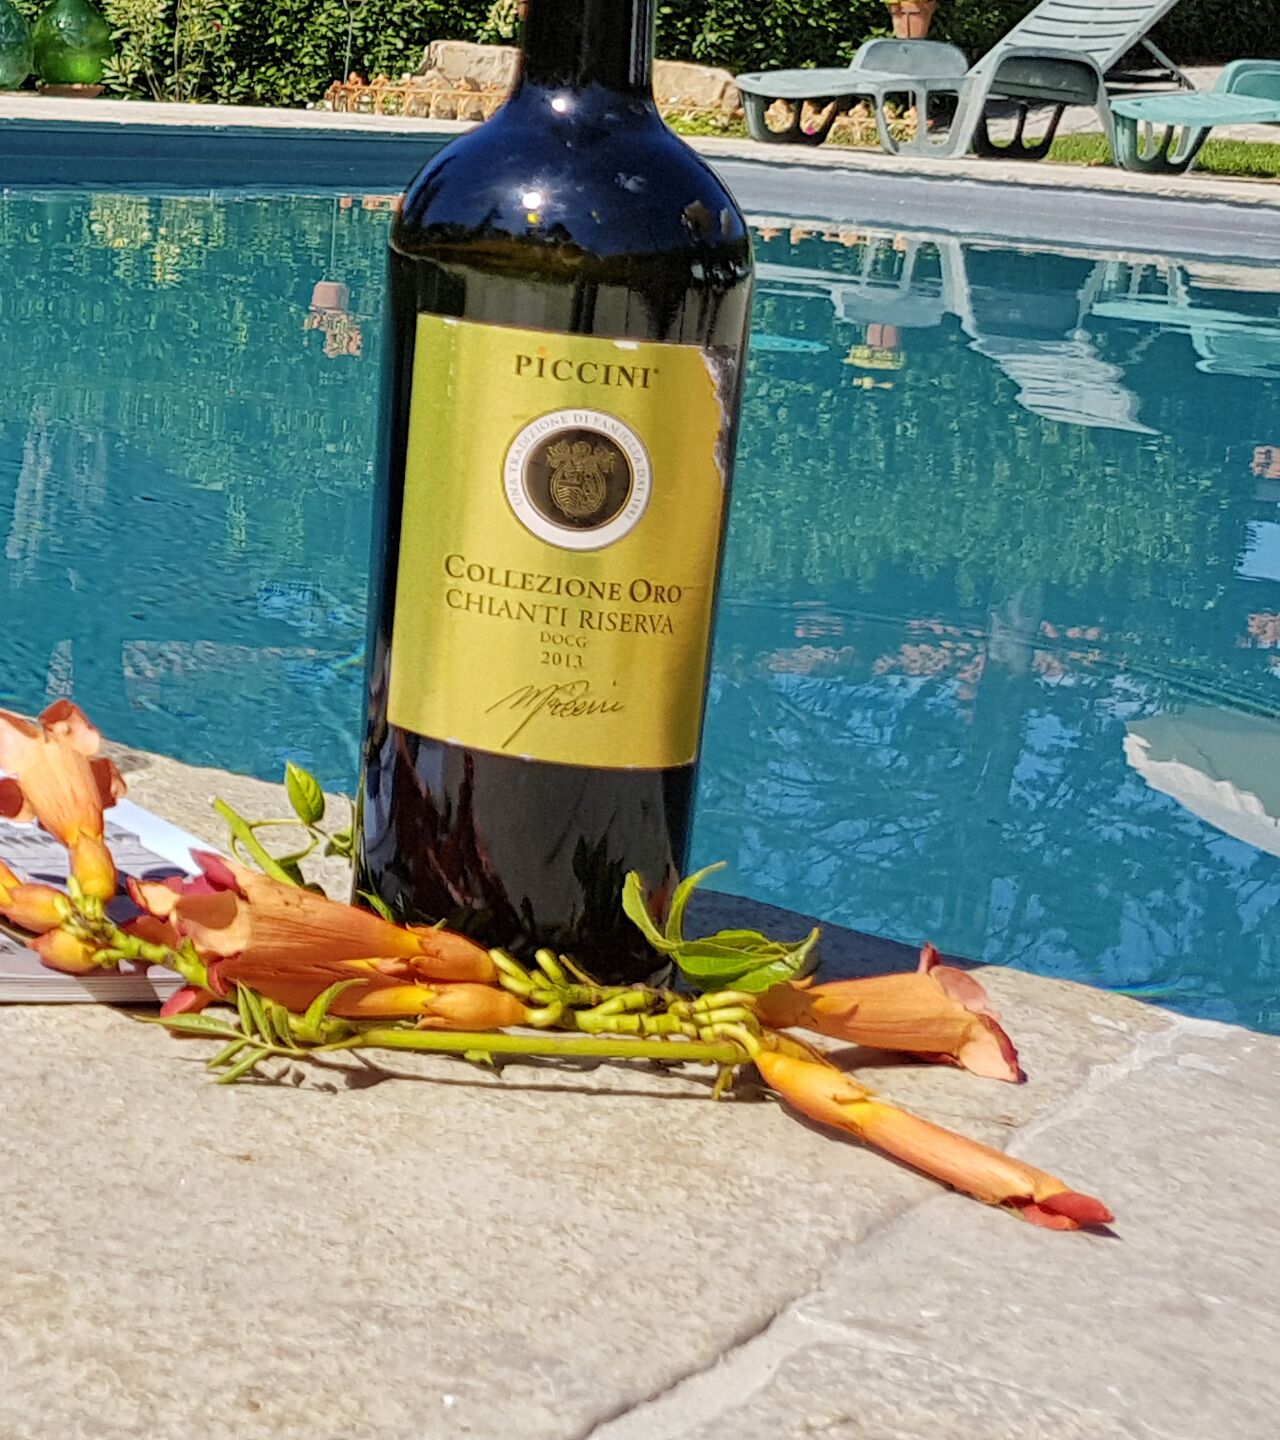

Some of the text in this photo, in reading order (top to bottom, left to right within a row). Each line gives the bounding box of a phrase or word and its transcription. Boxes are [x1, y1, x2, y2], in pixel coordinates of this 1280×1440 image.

[515, 354, 651, 389] PICCINI
[573, 412, 590, 424] DI
[445, 588, 674, 635] CHIANTI RISERVA
[540, 630, 588, 649] DOCG
[540, 650, 584, 669] 2013
